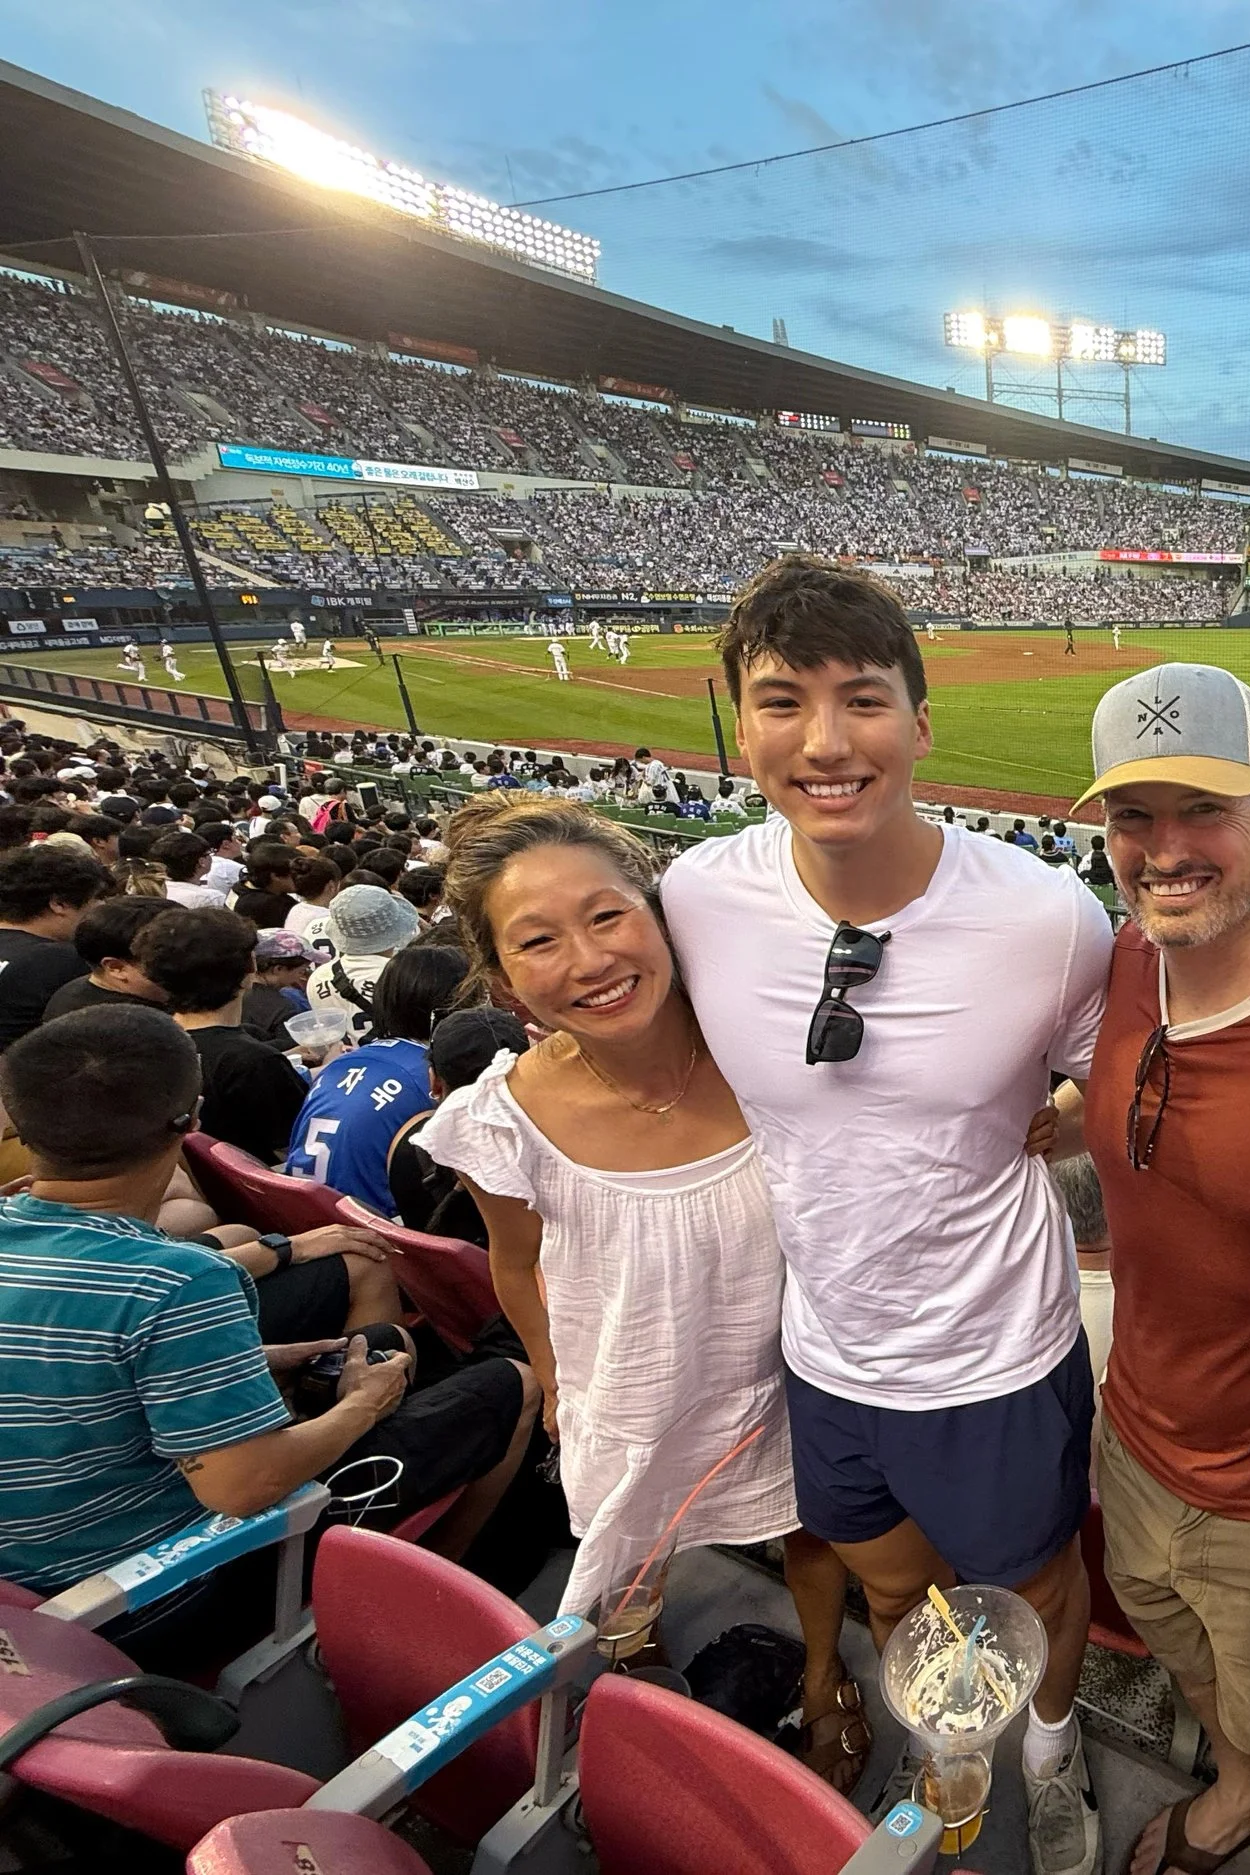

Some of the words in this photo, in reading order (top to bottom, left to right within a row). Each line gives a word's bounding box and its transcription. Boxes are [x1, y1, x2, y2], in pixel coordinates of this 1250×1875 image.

[1155, 696, 1162, 704] L
[1138, 713, 1147, 722] N
[1170, 710, 1180, 719] O
[1153, 727, 1164, 735] A
[308, 1066, 403, 1112] 자욱
